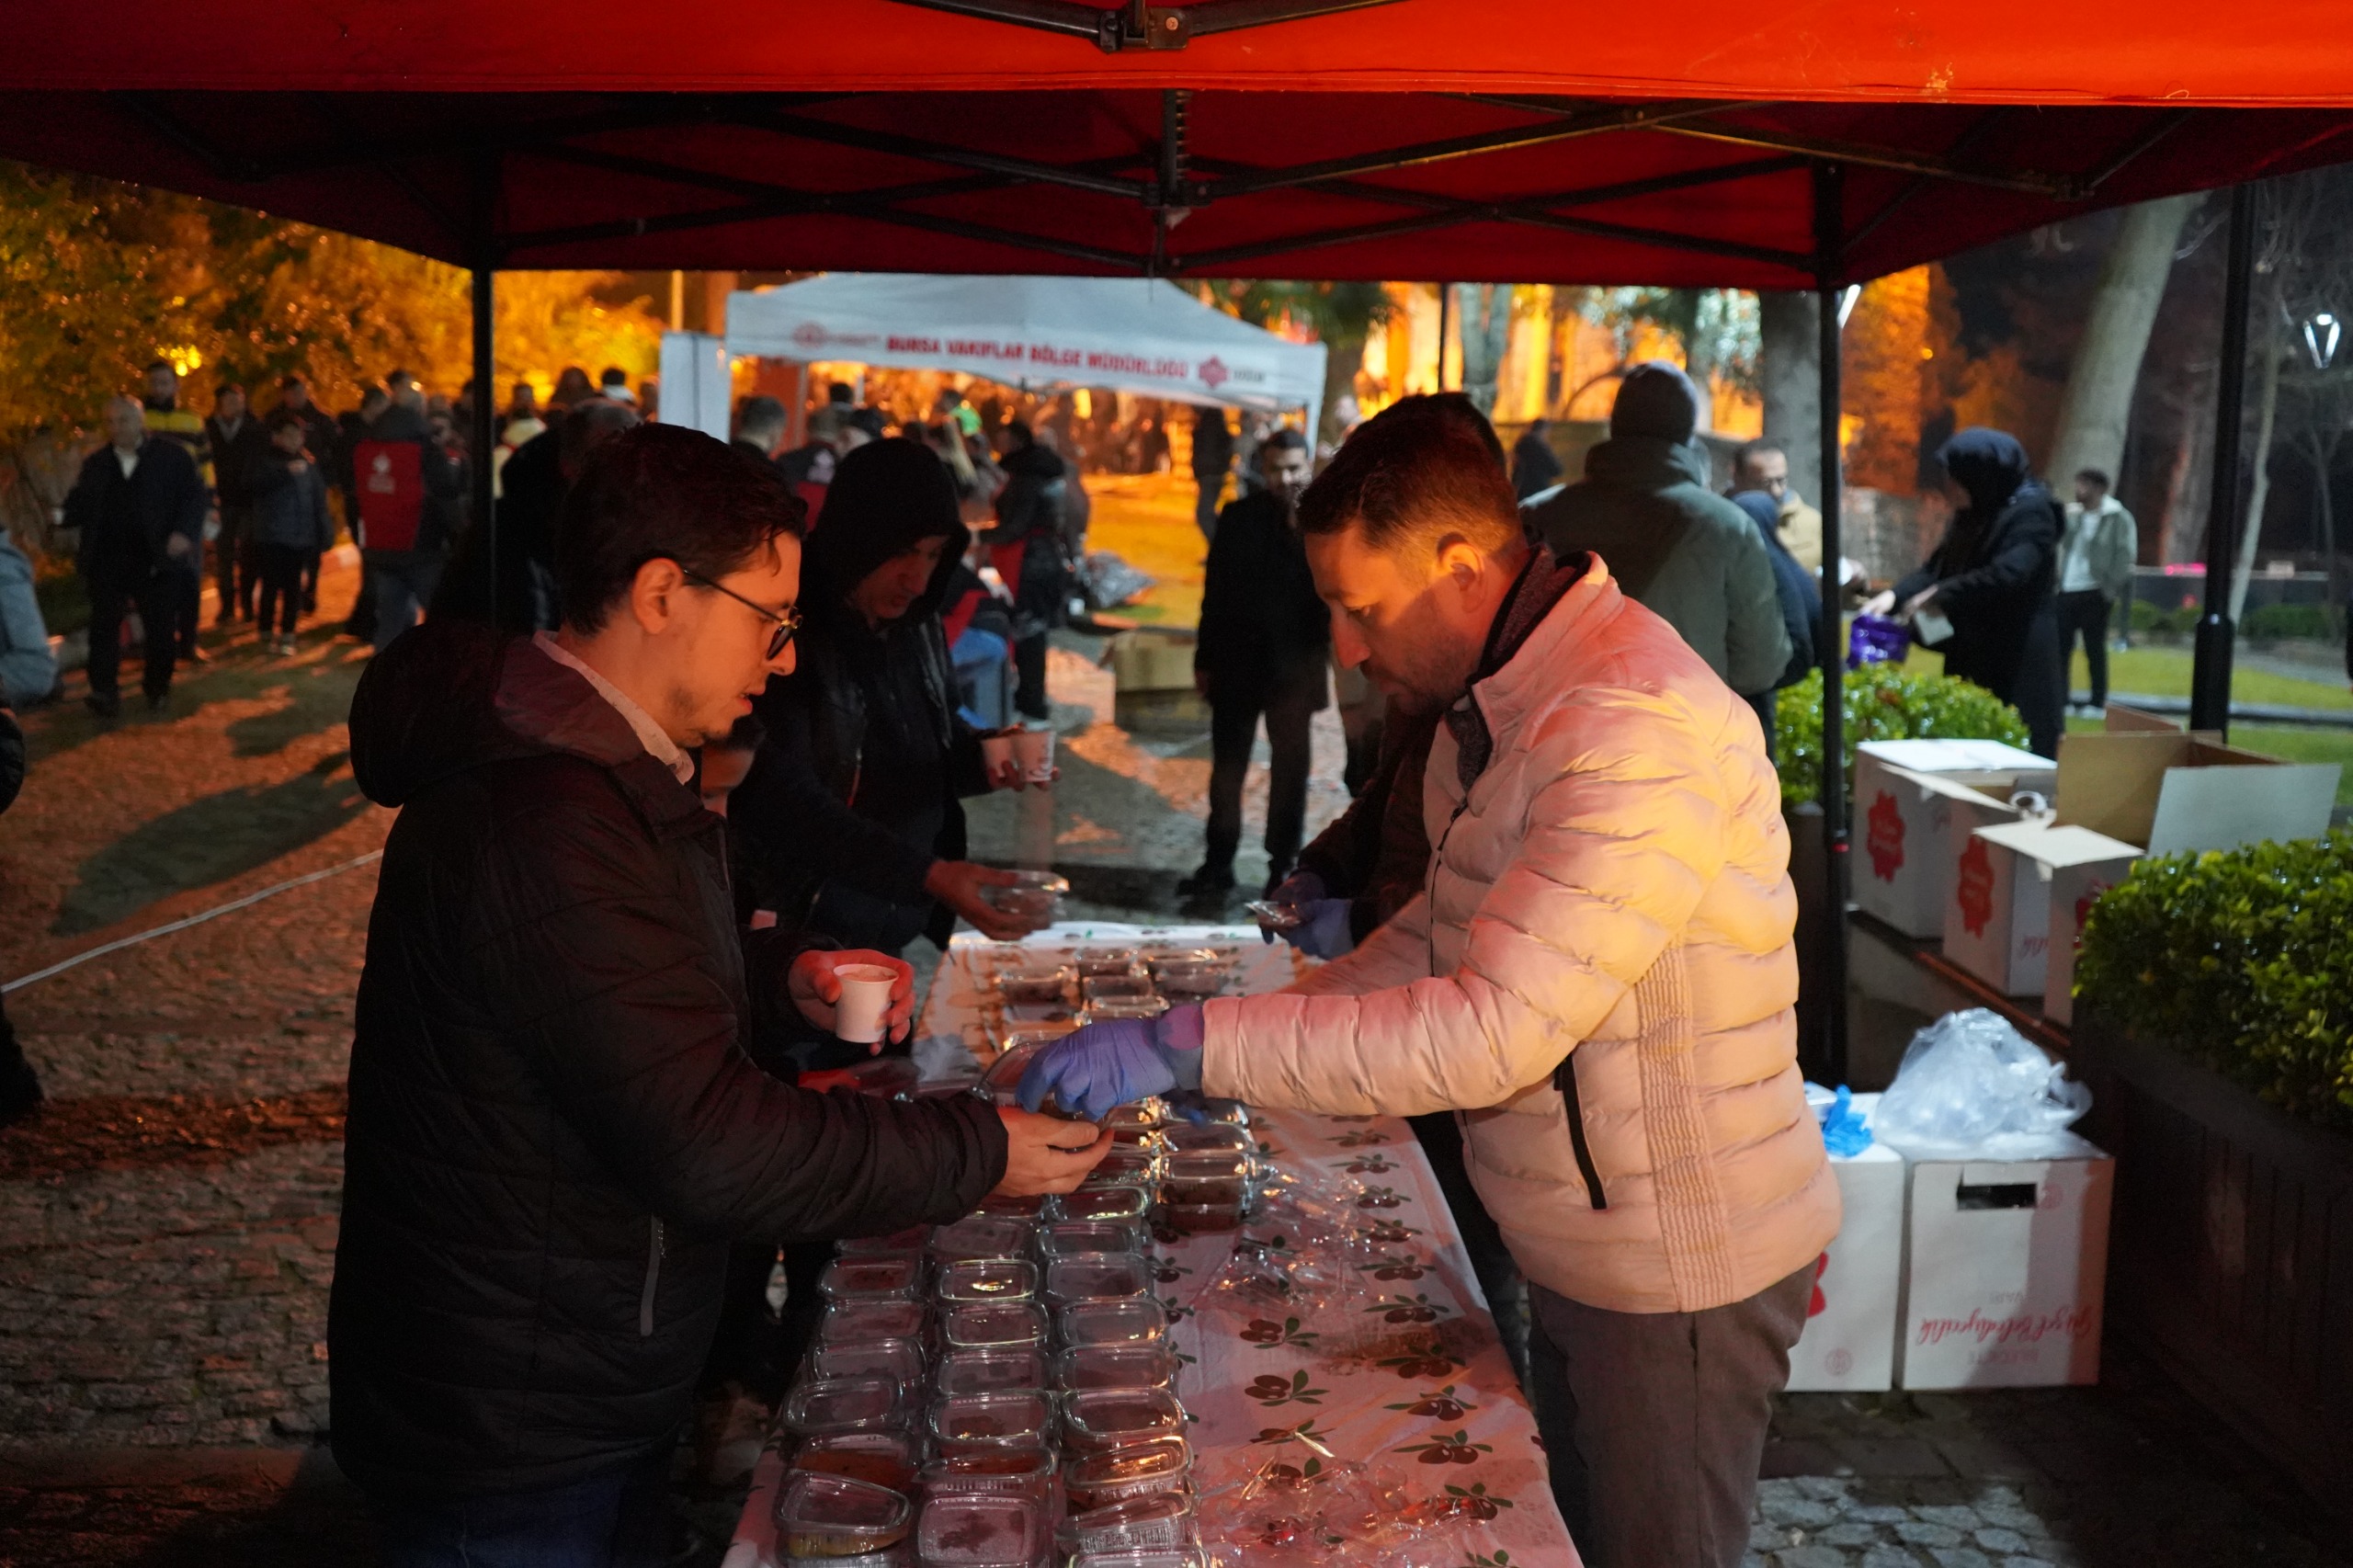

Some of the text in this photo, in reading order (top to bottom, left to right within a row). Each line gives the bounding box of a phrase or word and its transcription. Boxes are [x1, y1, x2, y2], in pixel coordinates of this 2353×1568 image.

[886, 335, 941, 353] BURSA
[947, 338, 1024, 359] VAKIFLAR
[1029, 343, 1081, 367] BÖLGE
